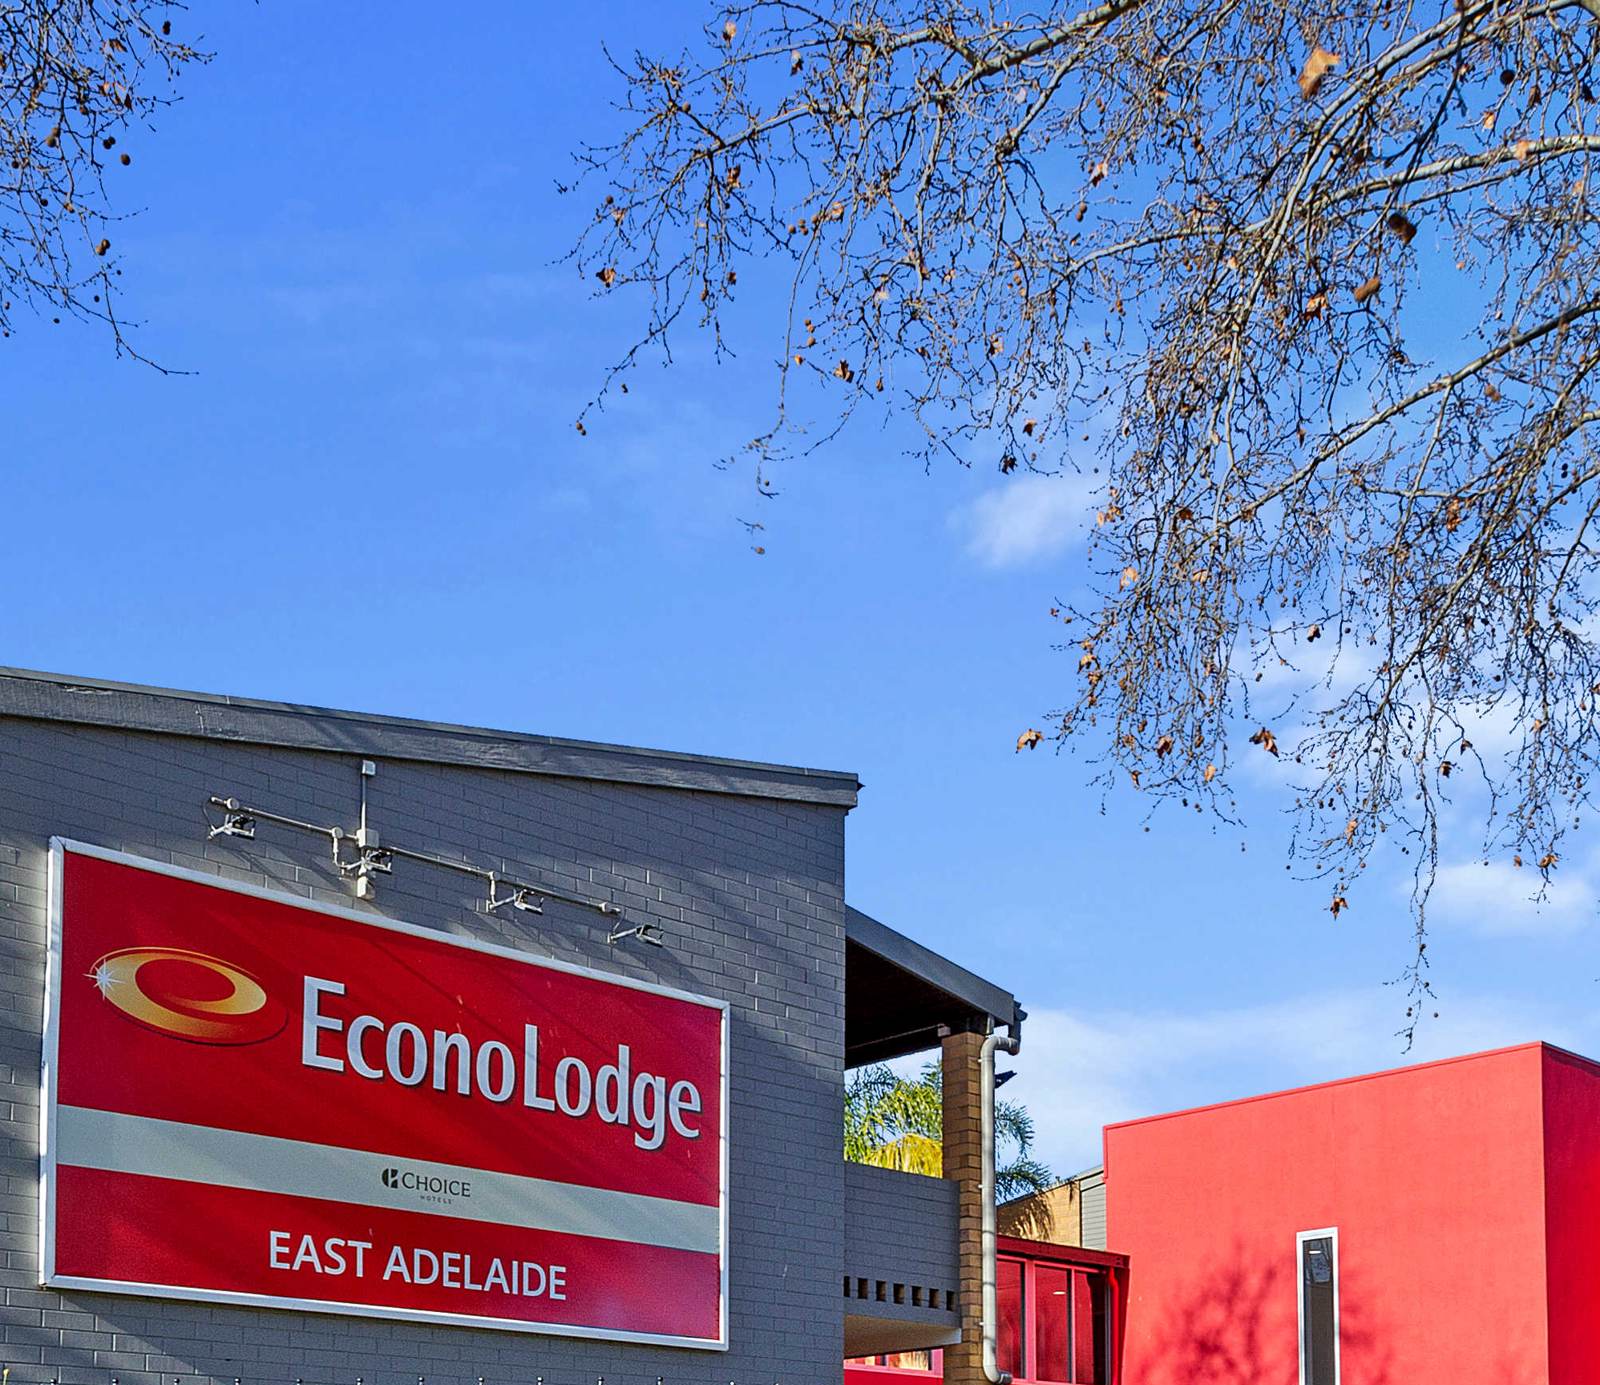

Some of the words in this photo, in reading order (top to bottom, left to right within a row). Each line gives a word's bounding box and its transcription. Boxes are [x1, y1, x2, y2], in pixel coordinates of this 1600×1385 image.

[302, 975, 703, 1151] EconoLodge
[401, 1171, 472, 1198] CHOICE
[269, 1230, 373, 1277] EAST
[382, 1246, 568, 1301] ADELAIDE
